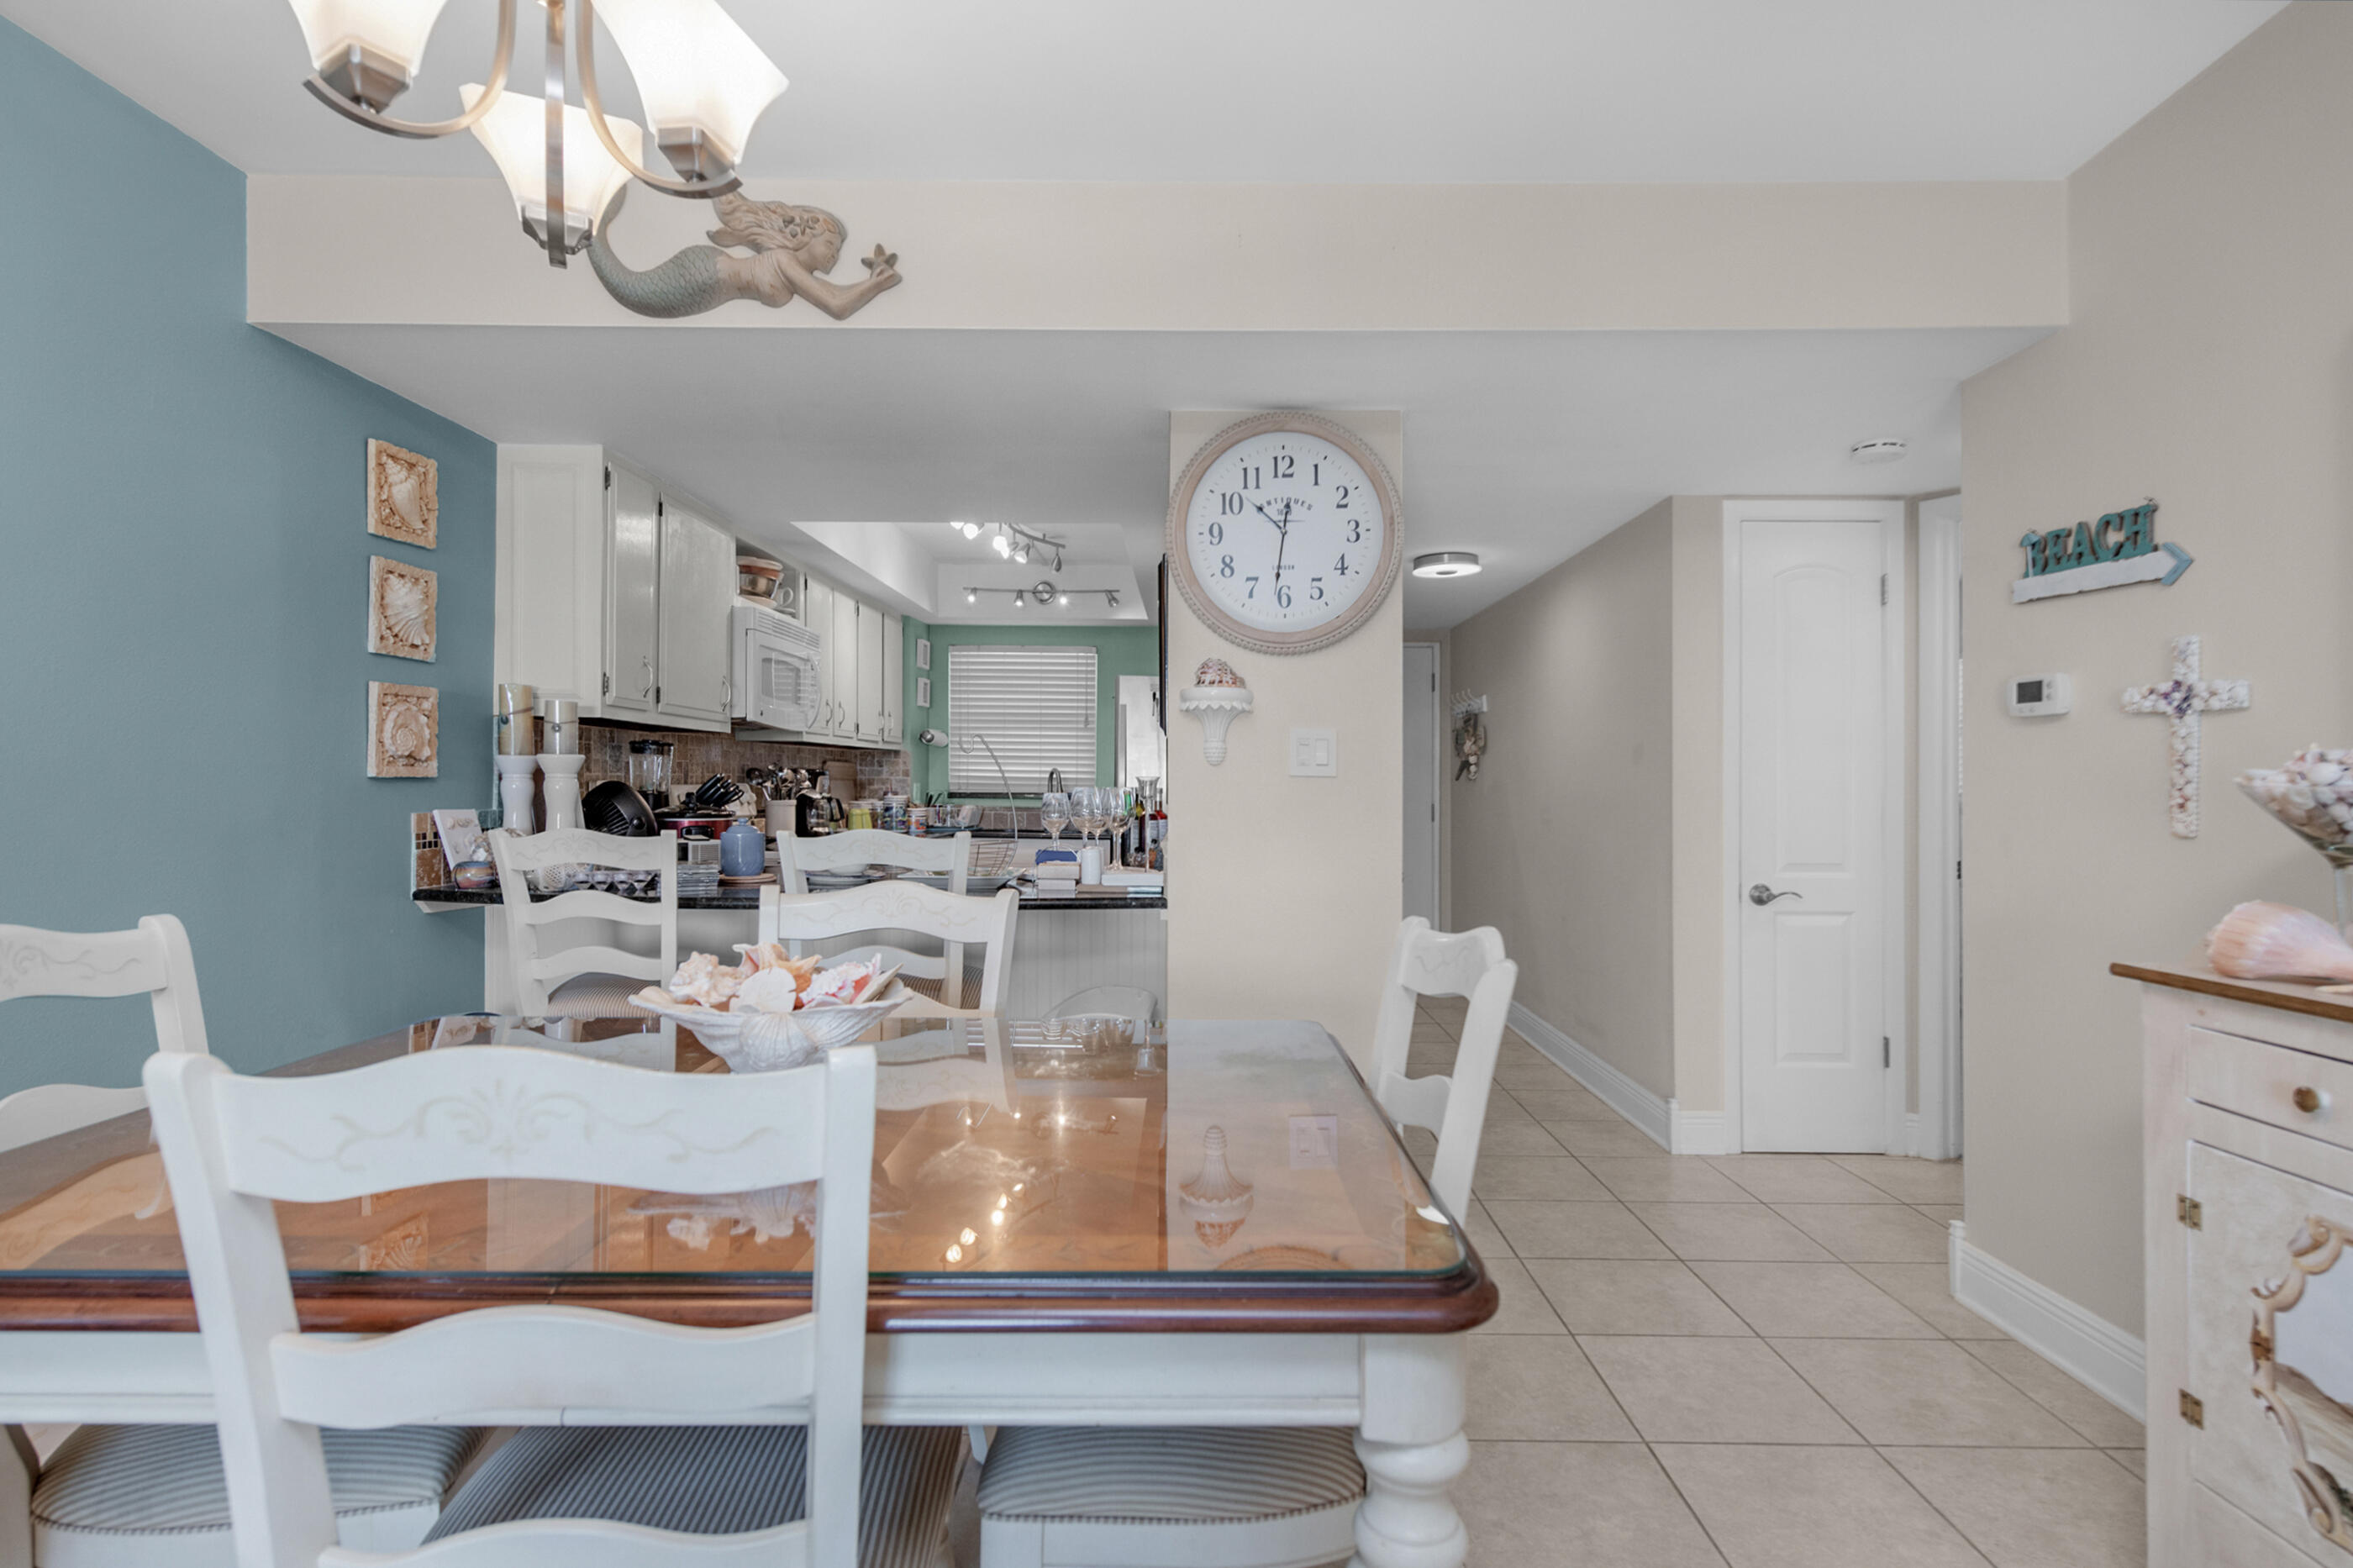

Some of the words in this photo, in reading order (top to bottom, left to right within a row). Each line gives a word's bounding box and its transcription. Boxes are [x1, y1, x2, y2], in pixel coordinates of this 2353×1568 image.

[1241, 466, 1261, 490] 11
[1271, 455, 1295, 479] 12
[1313, 463, 1320, 487] 1
[1220, 492, 1244, 516] 10
[1335, 485, 1350, 509] 2
[1208, 522, 1224, 545] 9
[1346, 519, 1361, 544] 3
[2023, 503, 2158, 579] BEACH
[1220, 555, 1234, 578] 8
[1334, 553, 1349, 576] 4
[1245, 576, 1259, 599] 7
[1277, 585, 1292, 608] 6
[1309, 576, 1324, 601] 5
